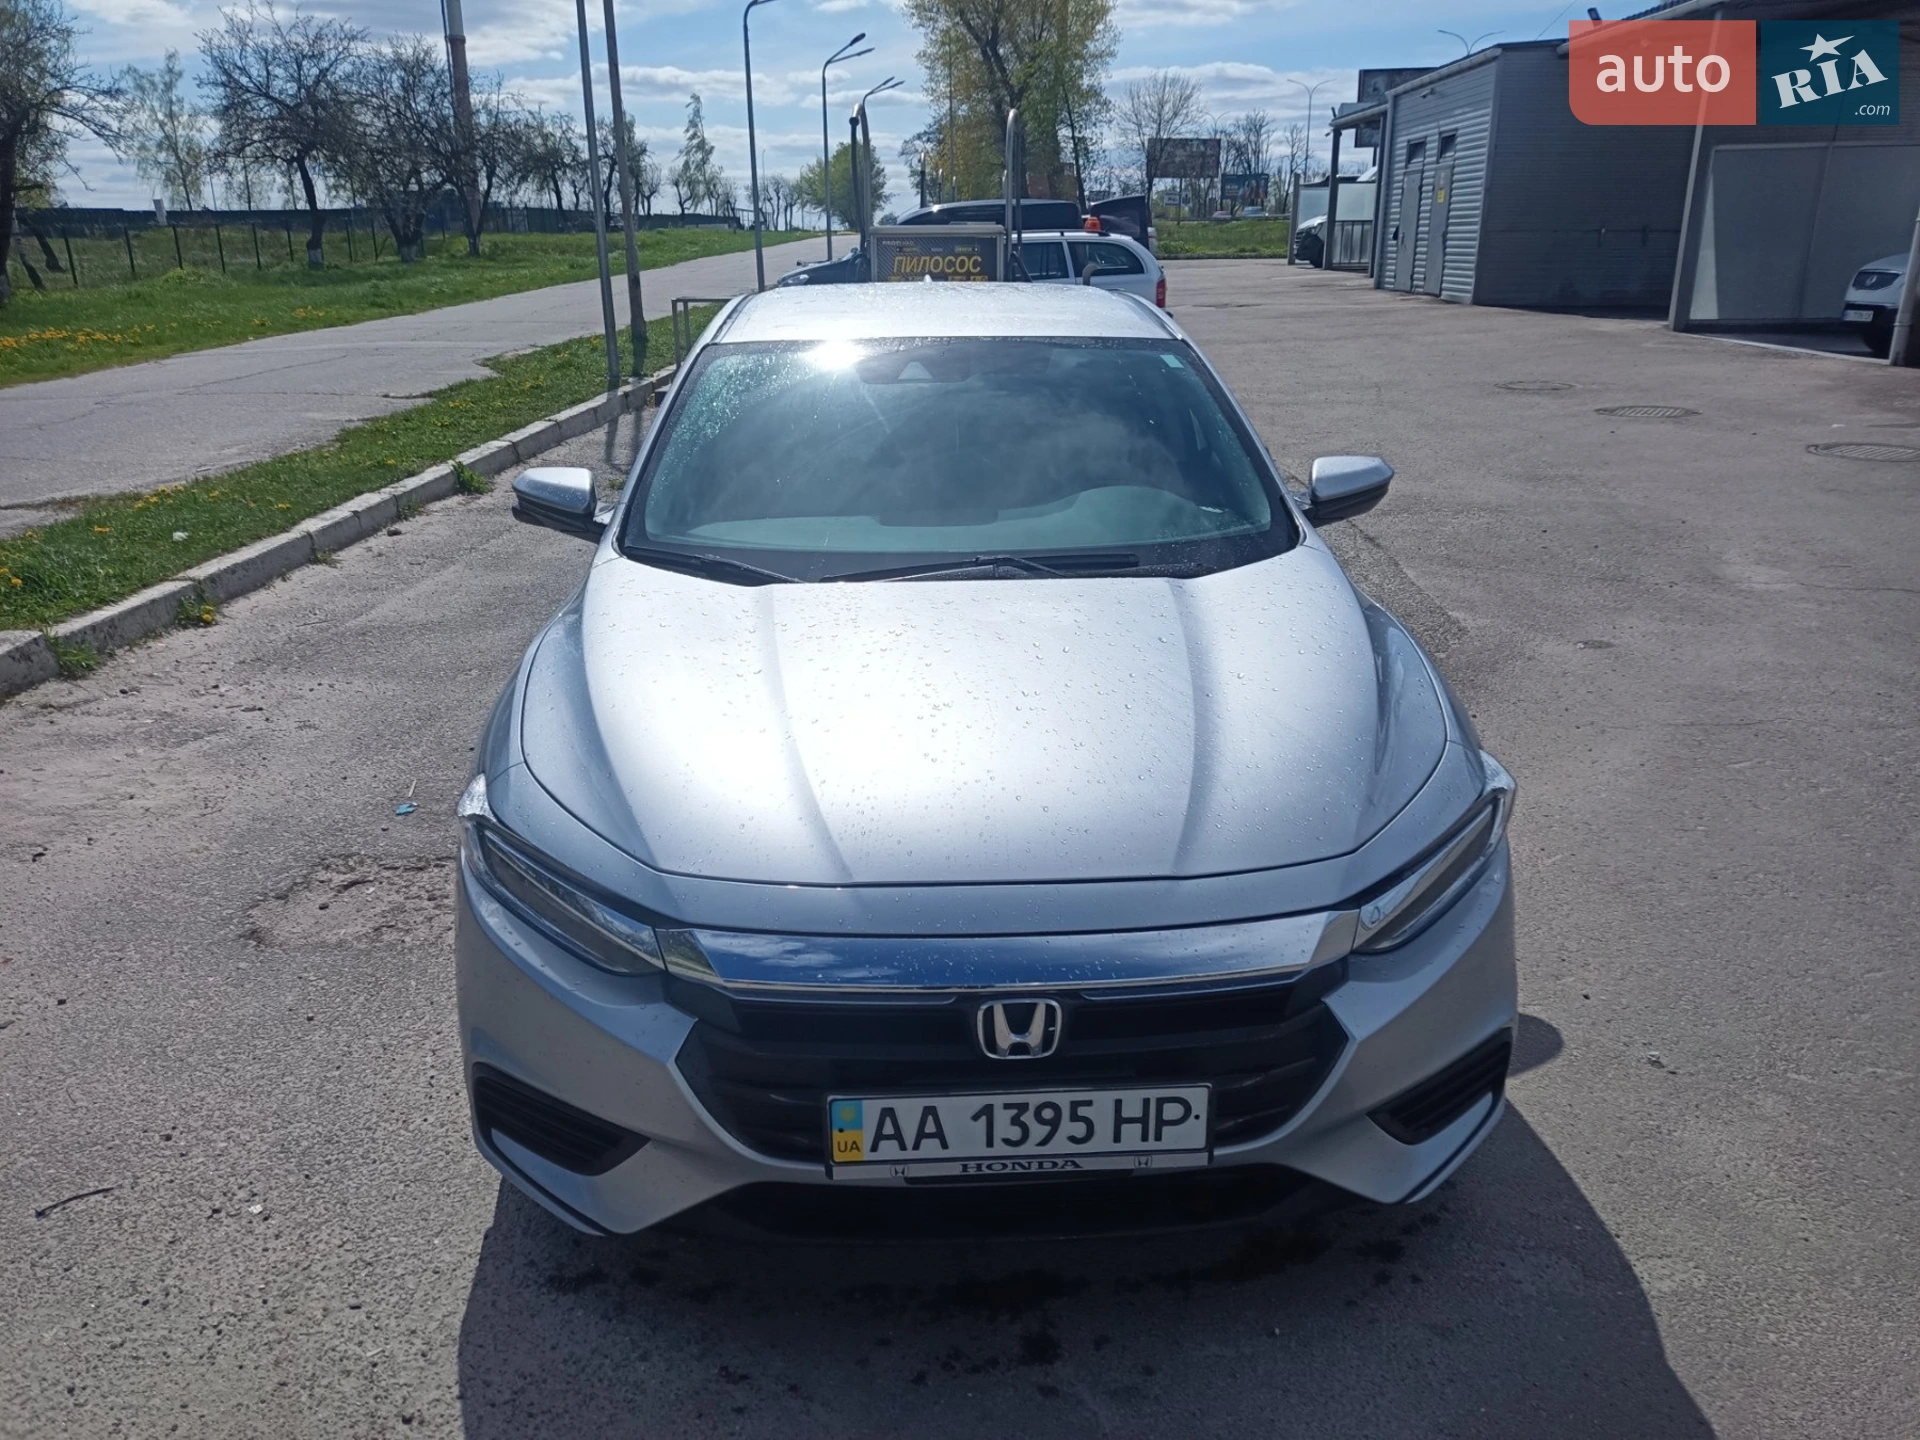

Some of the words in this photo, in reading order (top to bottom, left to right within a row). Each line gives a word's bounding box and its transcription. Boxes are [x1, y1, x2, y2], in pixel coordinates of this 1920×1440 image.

[893, 255, 982, 273] ПИЛОСОС
[869, 1106, 949, 1152] AA
[970, 1100, 1094, 1149] 1395
[1112, 1097, 1192, 1144] HP
[837, 1140, 861, 1153] UA
[959, 1160, 1082, 1174] HONDA
